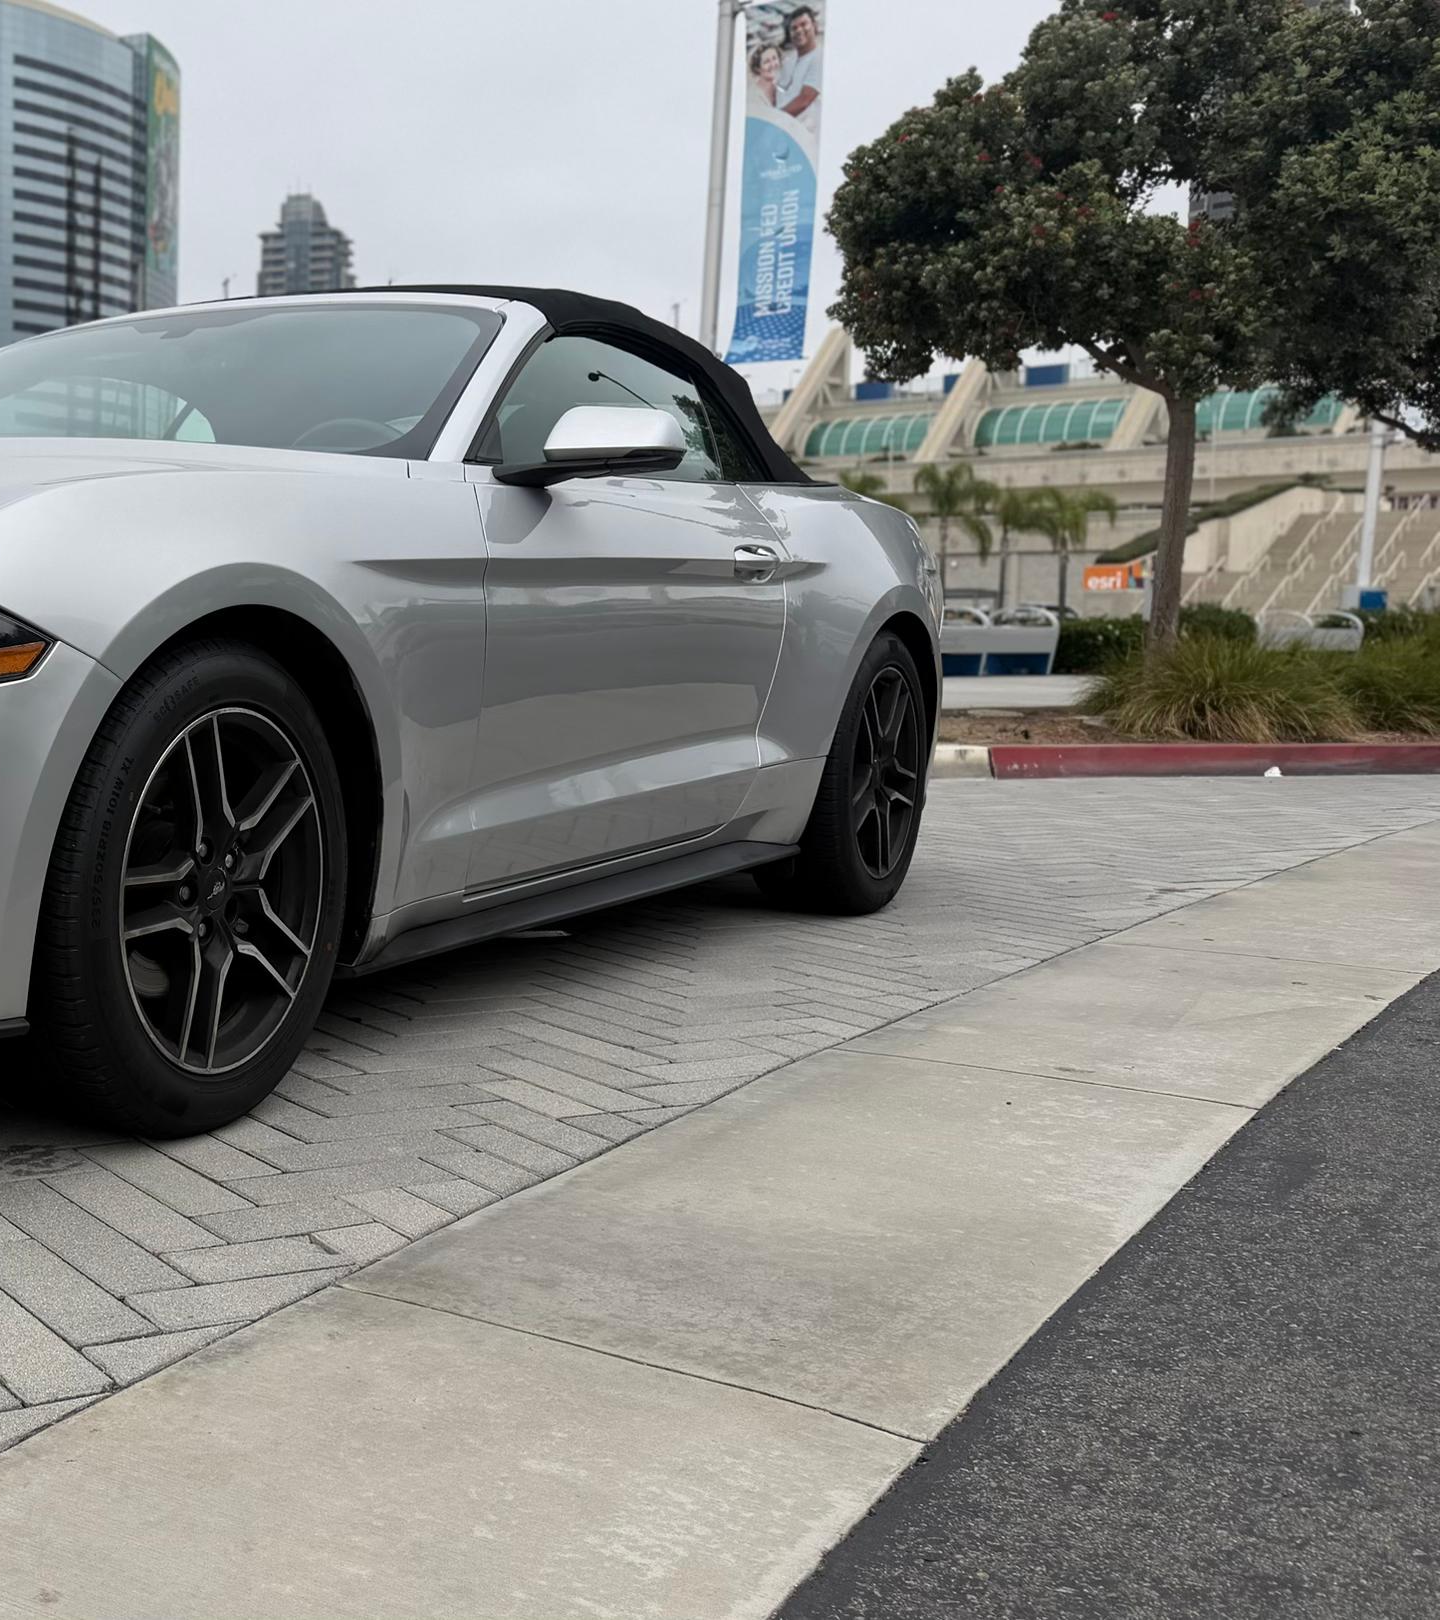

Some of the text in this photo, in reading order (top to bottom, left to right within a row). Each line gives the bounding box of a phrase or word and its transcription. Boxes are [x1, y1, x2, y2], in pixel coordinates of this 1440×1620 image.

[760, 205, 778, 237] FED
[779, 188, 801, 247] UNION
[753, 241, 776, 318] MISSION
[775, 251, 796, 314] CREDIT
[1087, 571, 1122, 589] esri
